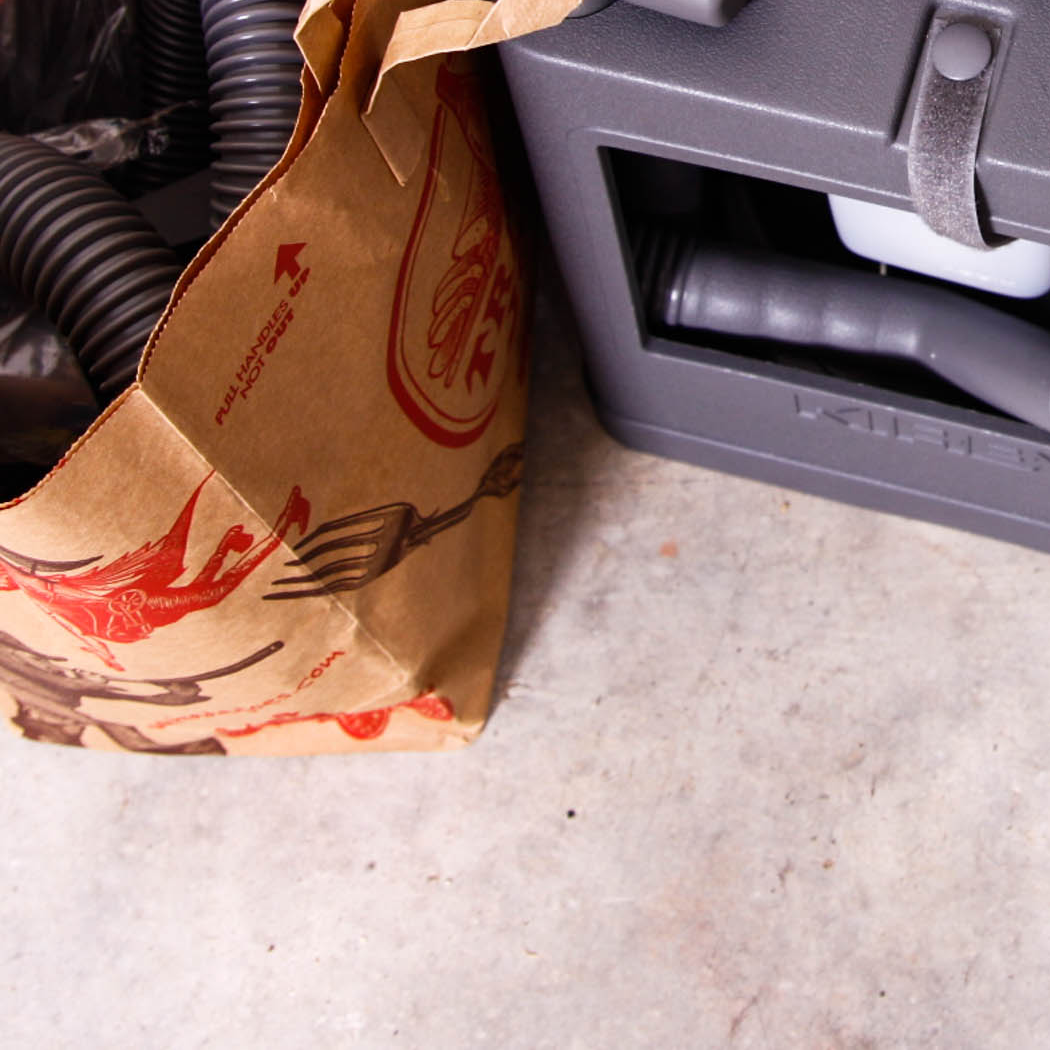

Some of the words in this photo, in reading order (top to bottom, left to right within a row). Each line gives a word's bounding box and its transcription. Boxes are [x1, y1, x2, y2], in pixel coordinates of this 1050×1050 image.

[215, 384, 239, 426] PULL
[235, 300, 288, 382] HANDLES
[288, 267, 310, 297] UP
[240, 356, 266, 399] NOT
[265, 308, 294, 354] OUT
